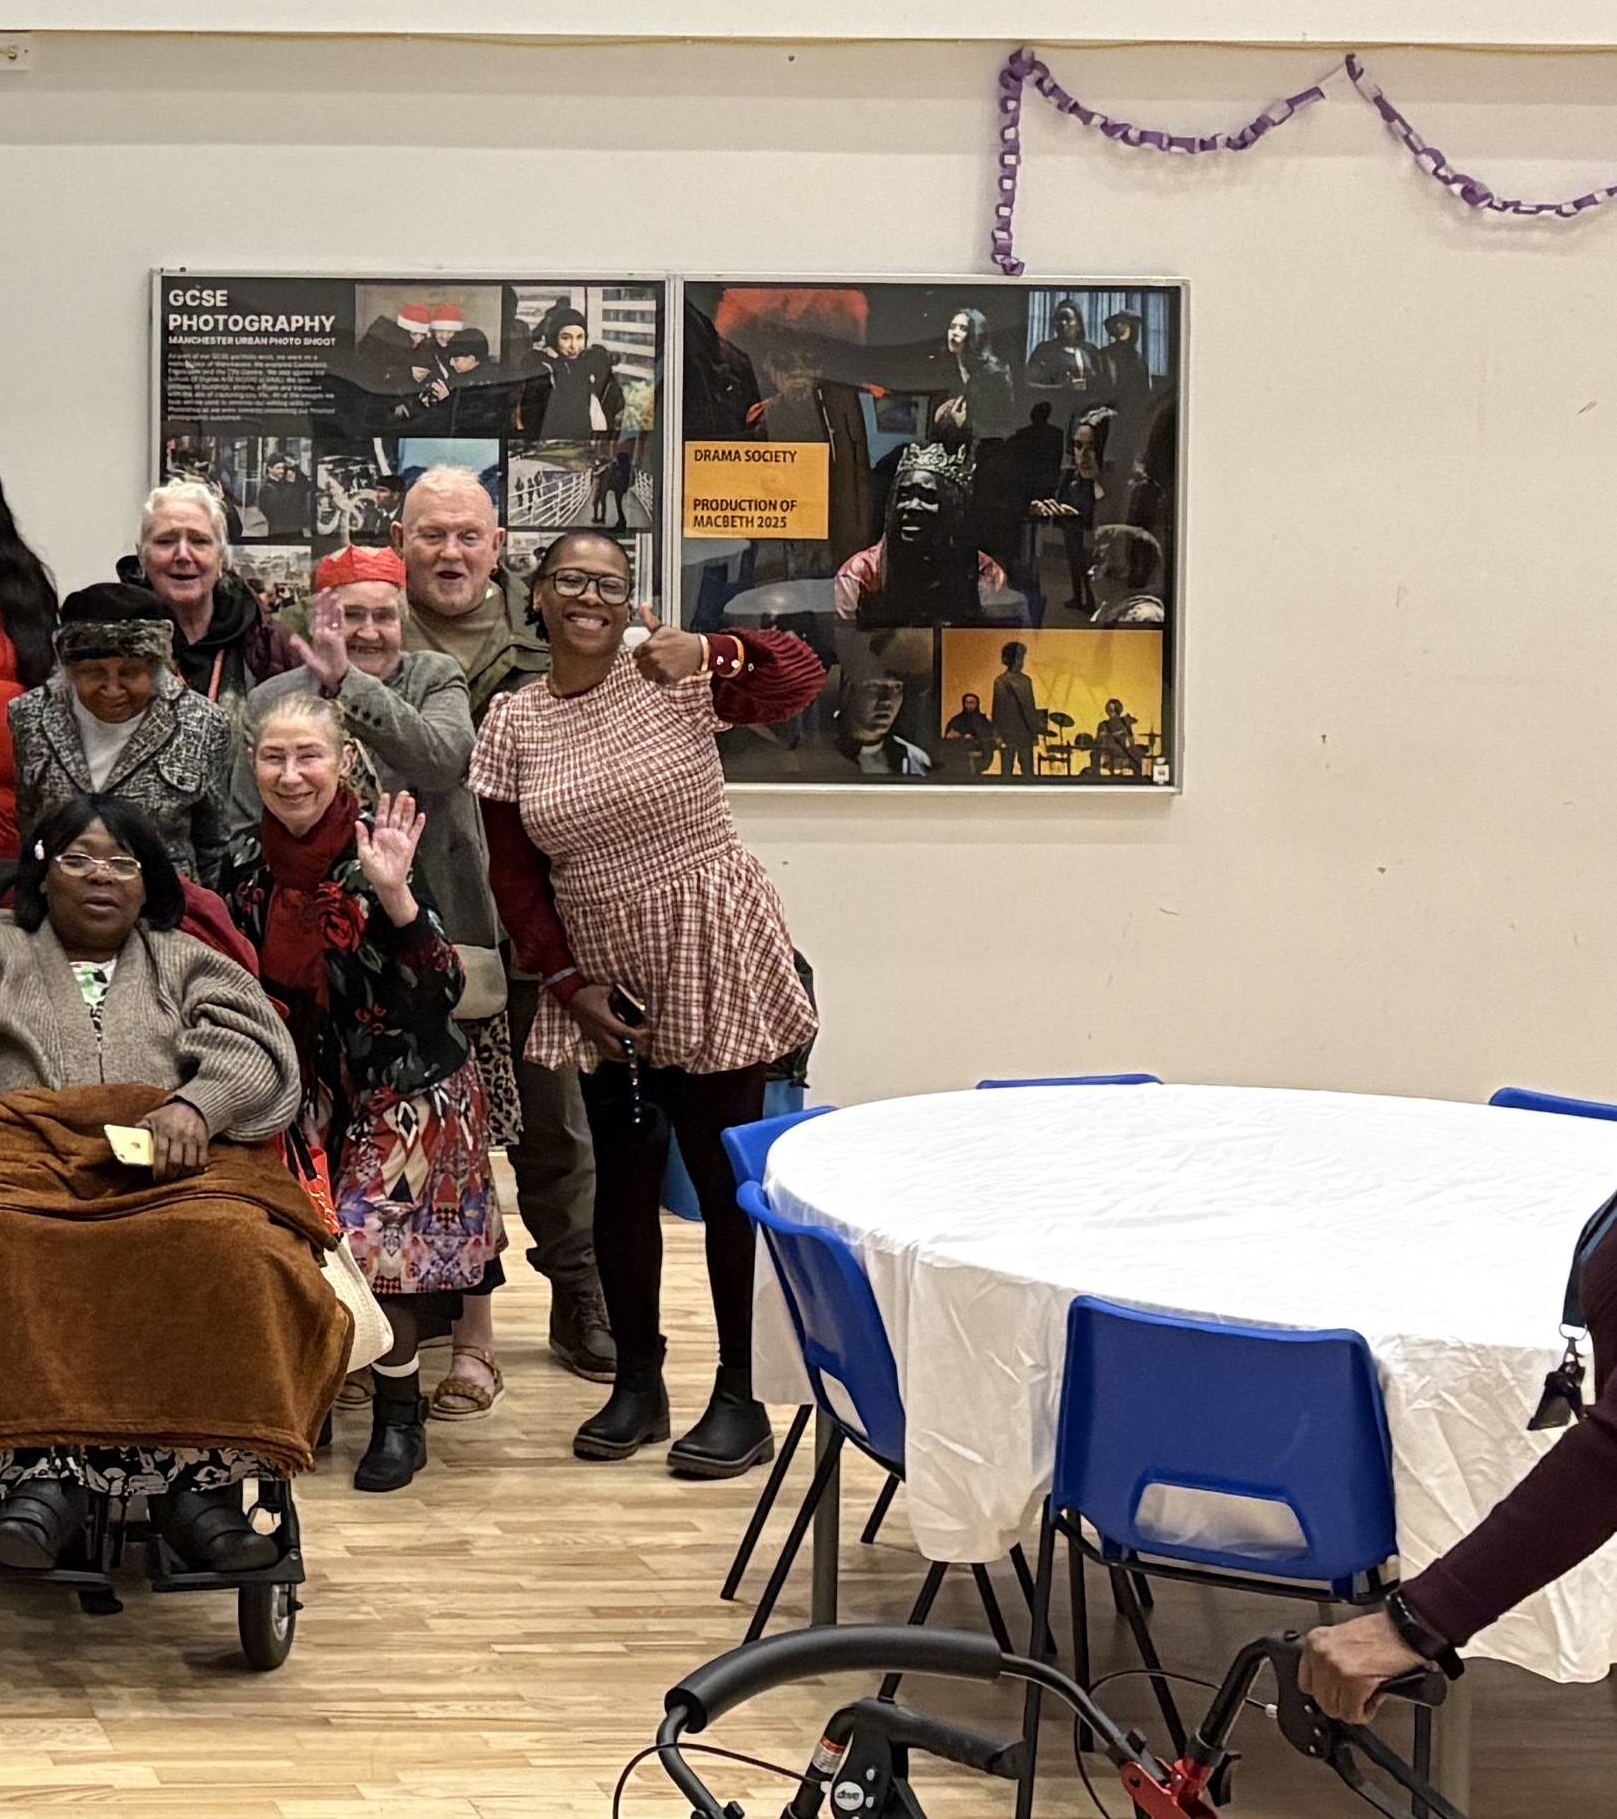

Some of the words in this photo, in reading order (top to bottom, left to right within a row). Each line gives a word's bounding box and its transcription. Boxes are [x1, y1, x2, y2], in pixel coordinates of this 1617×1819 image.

[168, 289, 229, 307] GCSE
[168, 314, 336, 333] PHOTOGRAPHY
[168, 336, 233, 346] MANCHESTER
[235, 337, 268, 346] URBAN
[269, 337, 302, 346] PHOTO
[694, 449, 742, 462] DRAMA
[744, 450, 798, 463] SOCIETY
[693, 498, 778, 512] PRODUCTION
[779, 499, 798, 513] OF
[693, 514, 755, 528] MACBETH
[757, 516, 787, 529] 2025
